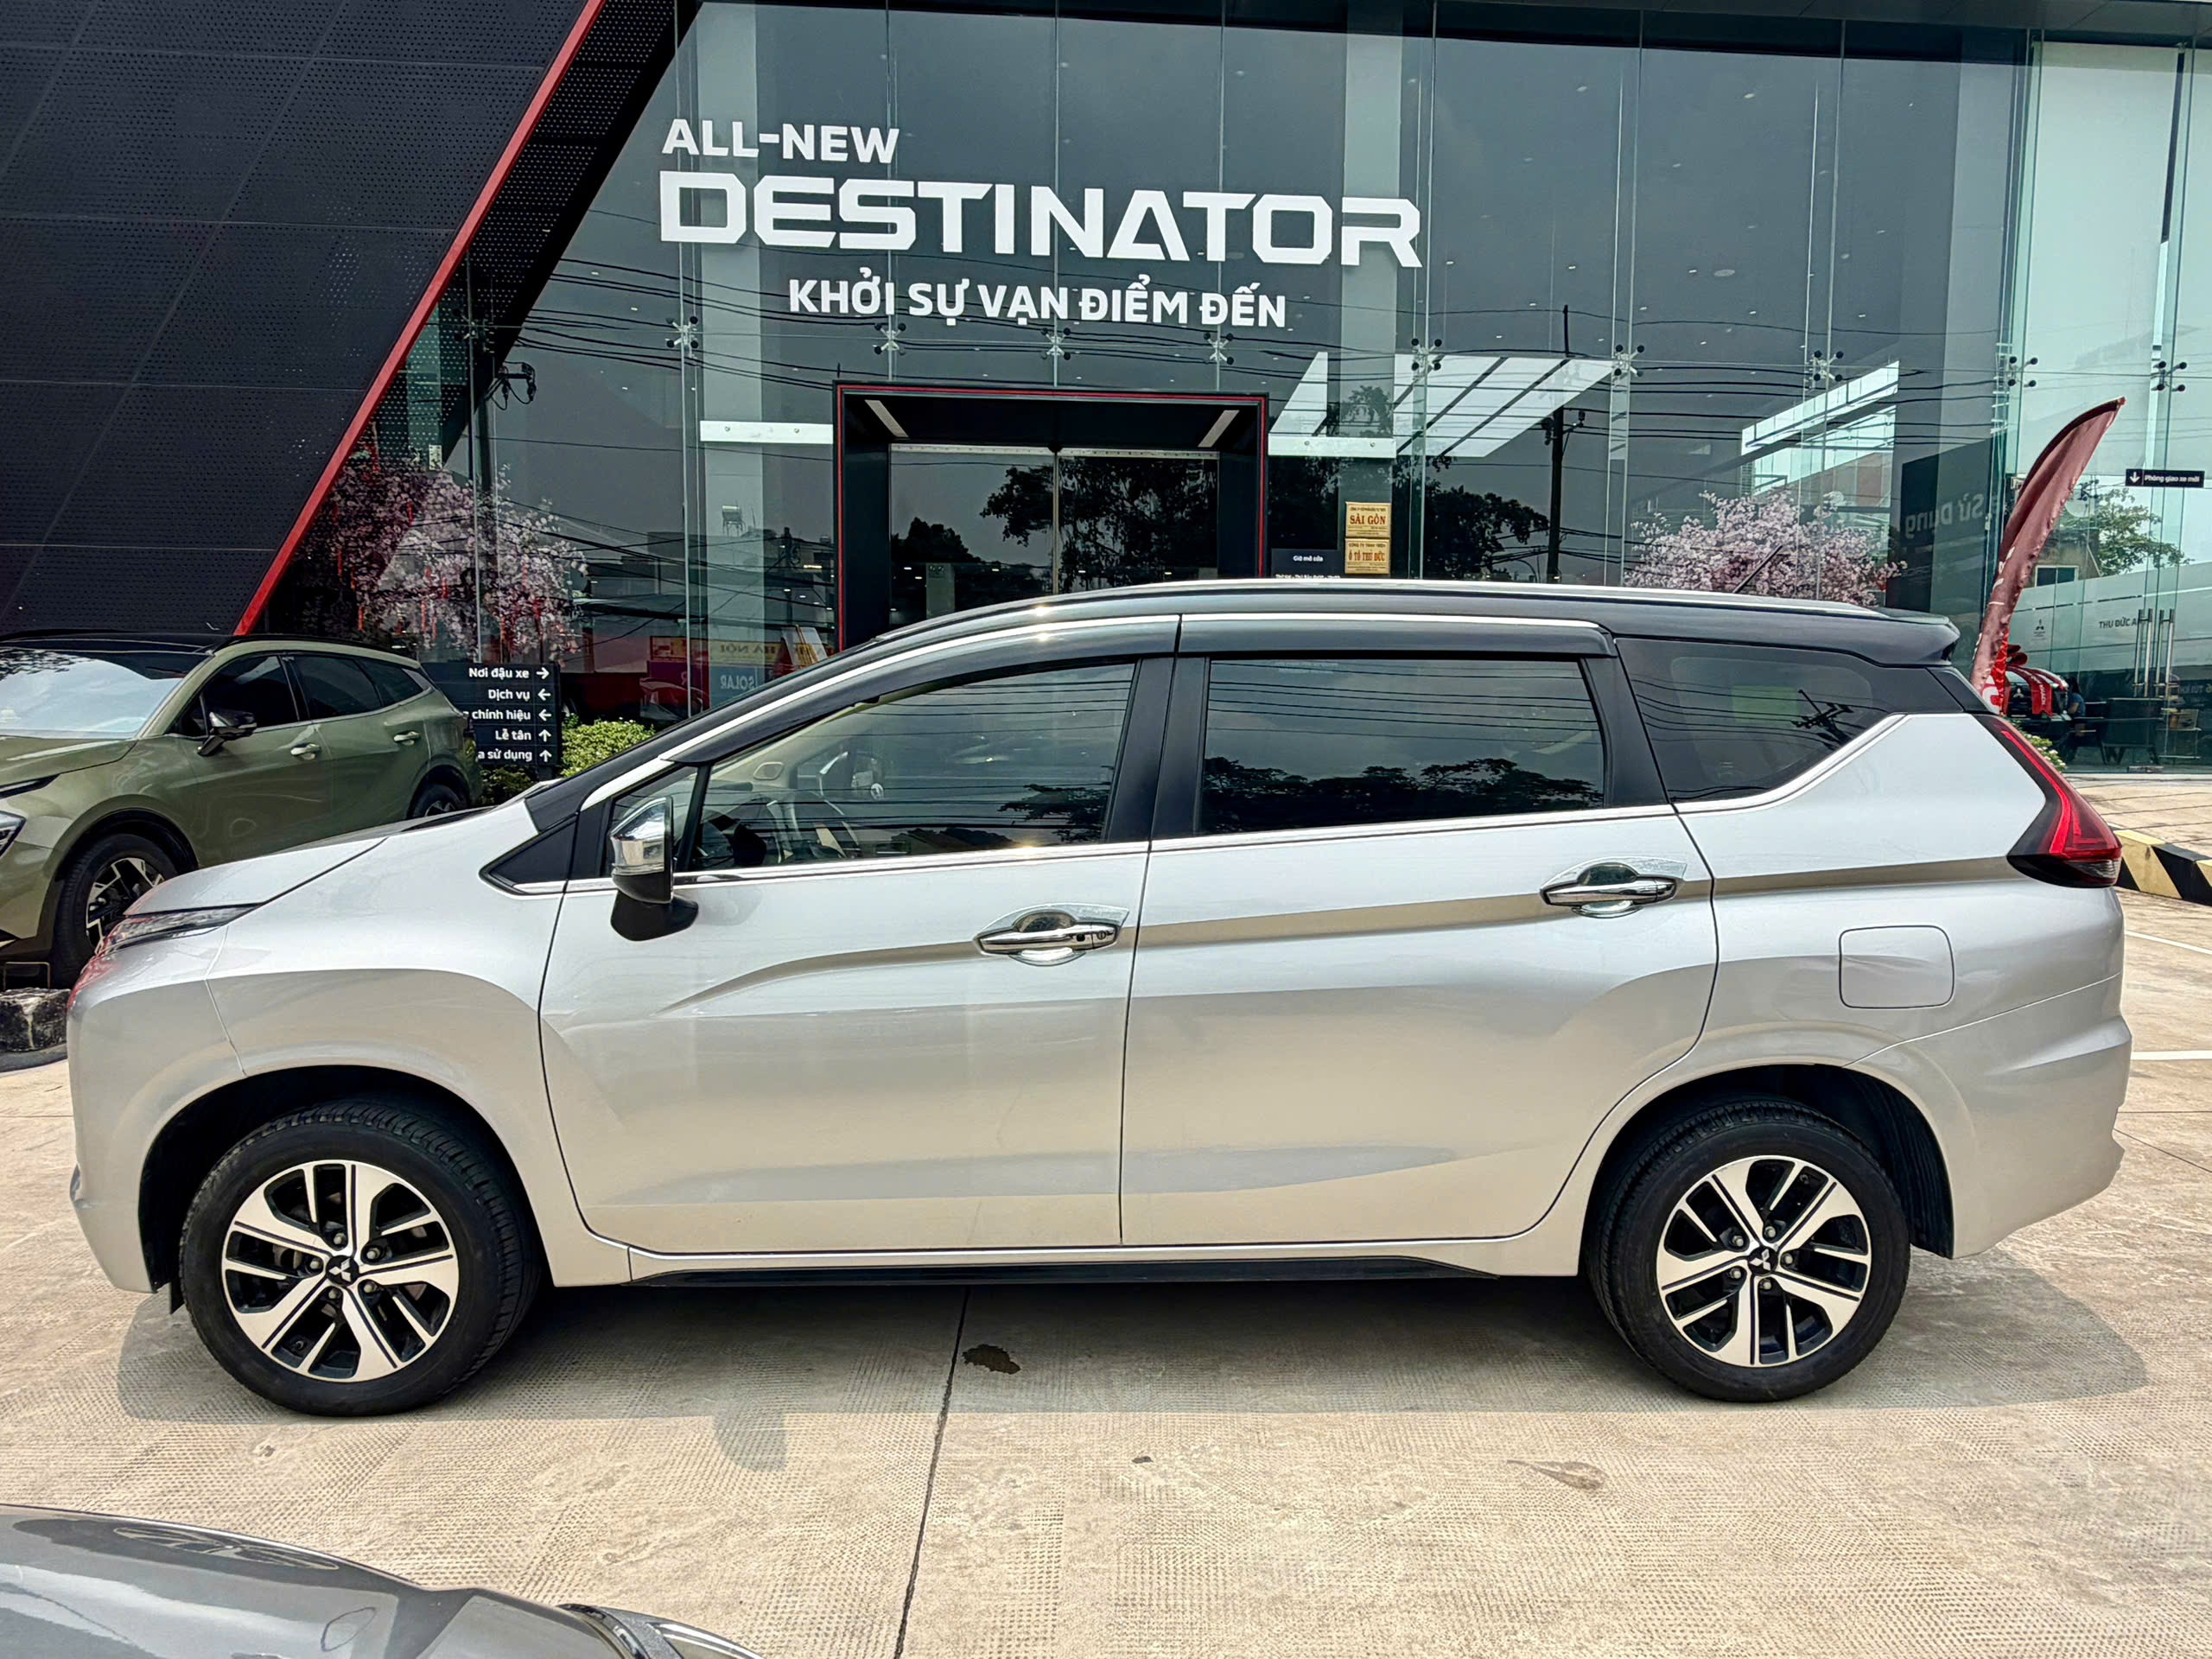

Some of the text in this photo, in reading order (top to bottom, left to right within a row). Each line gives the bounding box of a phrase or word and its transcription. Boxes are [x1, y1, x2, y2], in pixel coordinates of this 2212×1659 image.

[661, 118, 899, 164] ALL-NEW
[659, 170, 1421, 268] DESTINATOR
[789, 267, 1285, 327] KHỞI SỰ VẠN ĐIỂM ĐẾN
[468, 667, 488, 677] Nơi
[515, 670, 530, 678] xe
[488, 689, 531, 702] Dịch vụ
[472, 709, 504, 719] chính
[505, 709, 531, 721] hiệu
[495, 728, 531, 741] Lễ tân
[487, 748, 501, 760] sử
[504, 749, 533, 762] dụng
